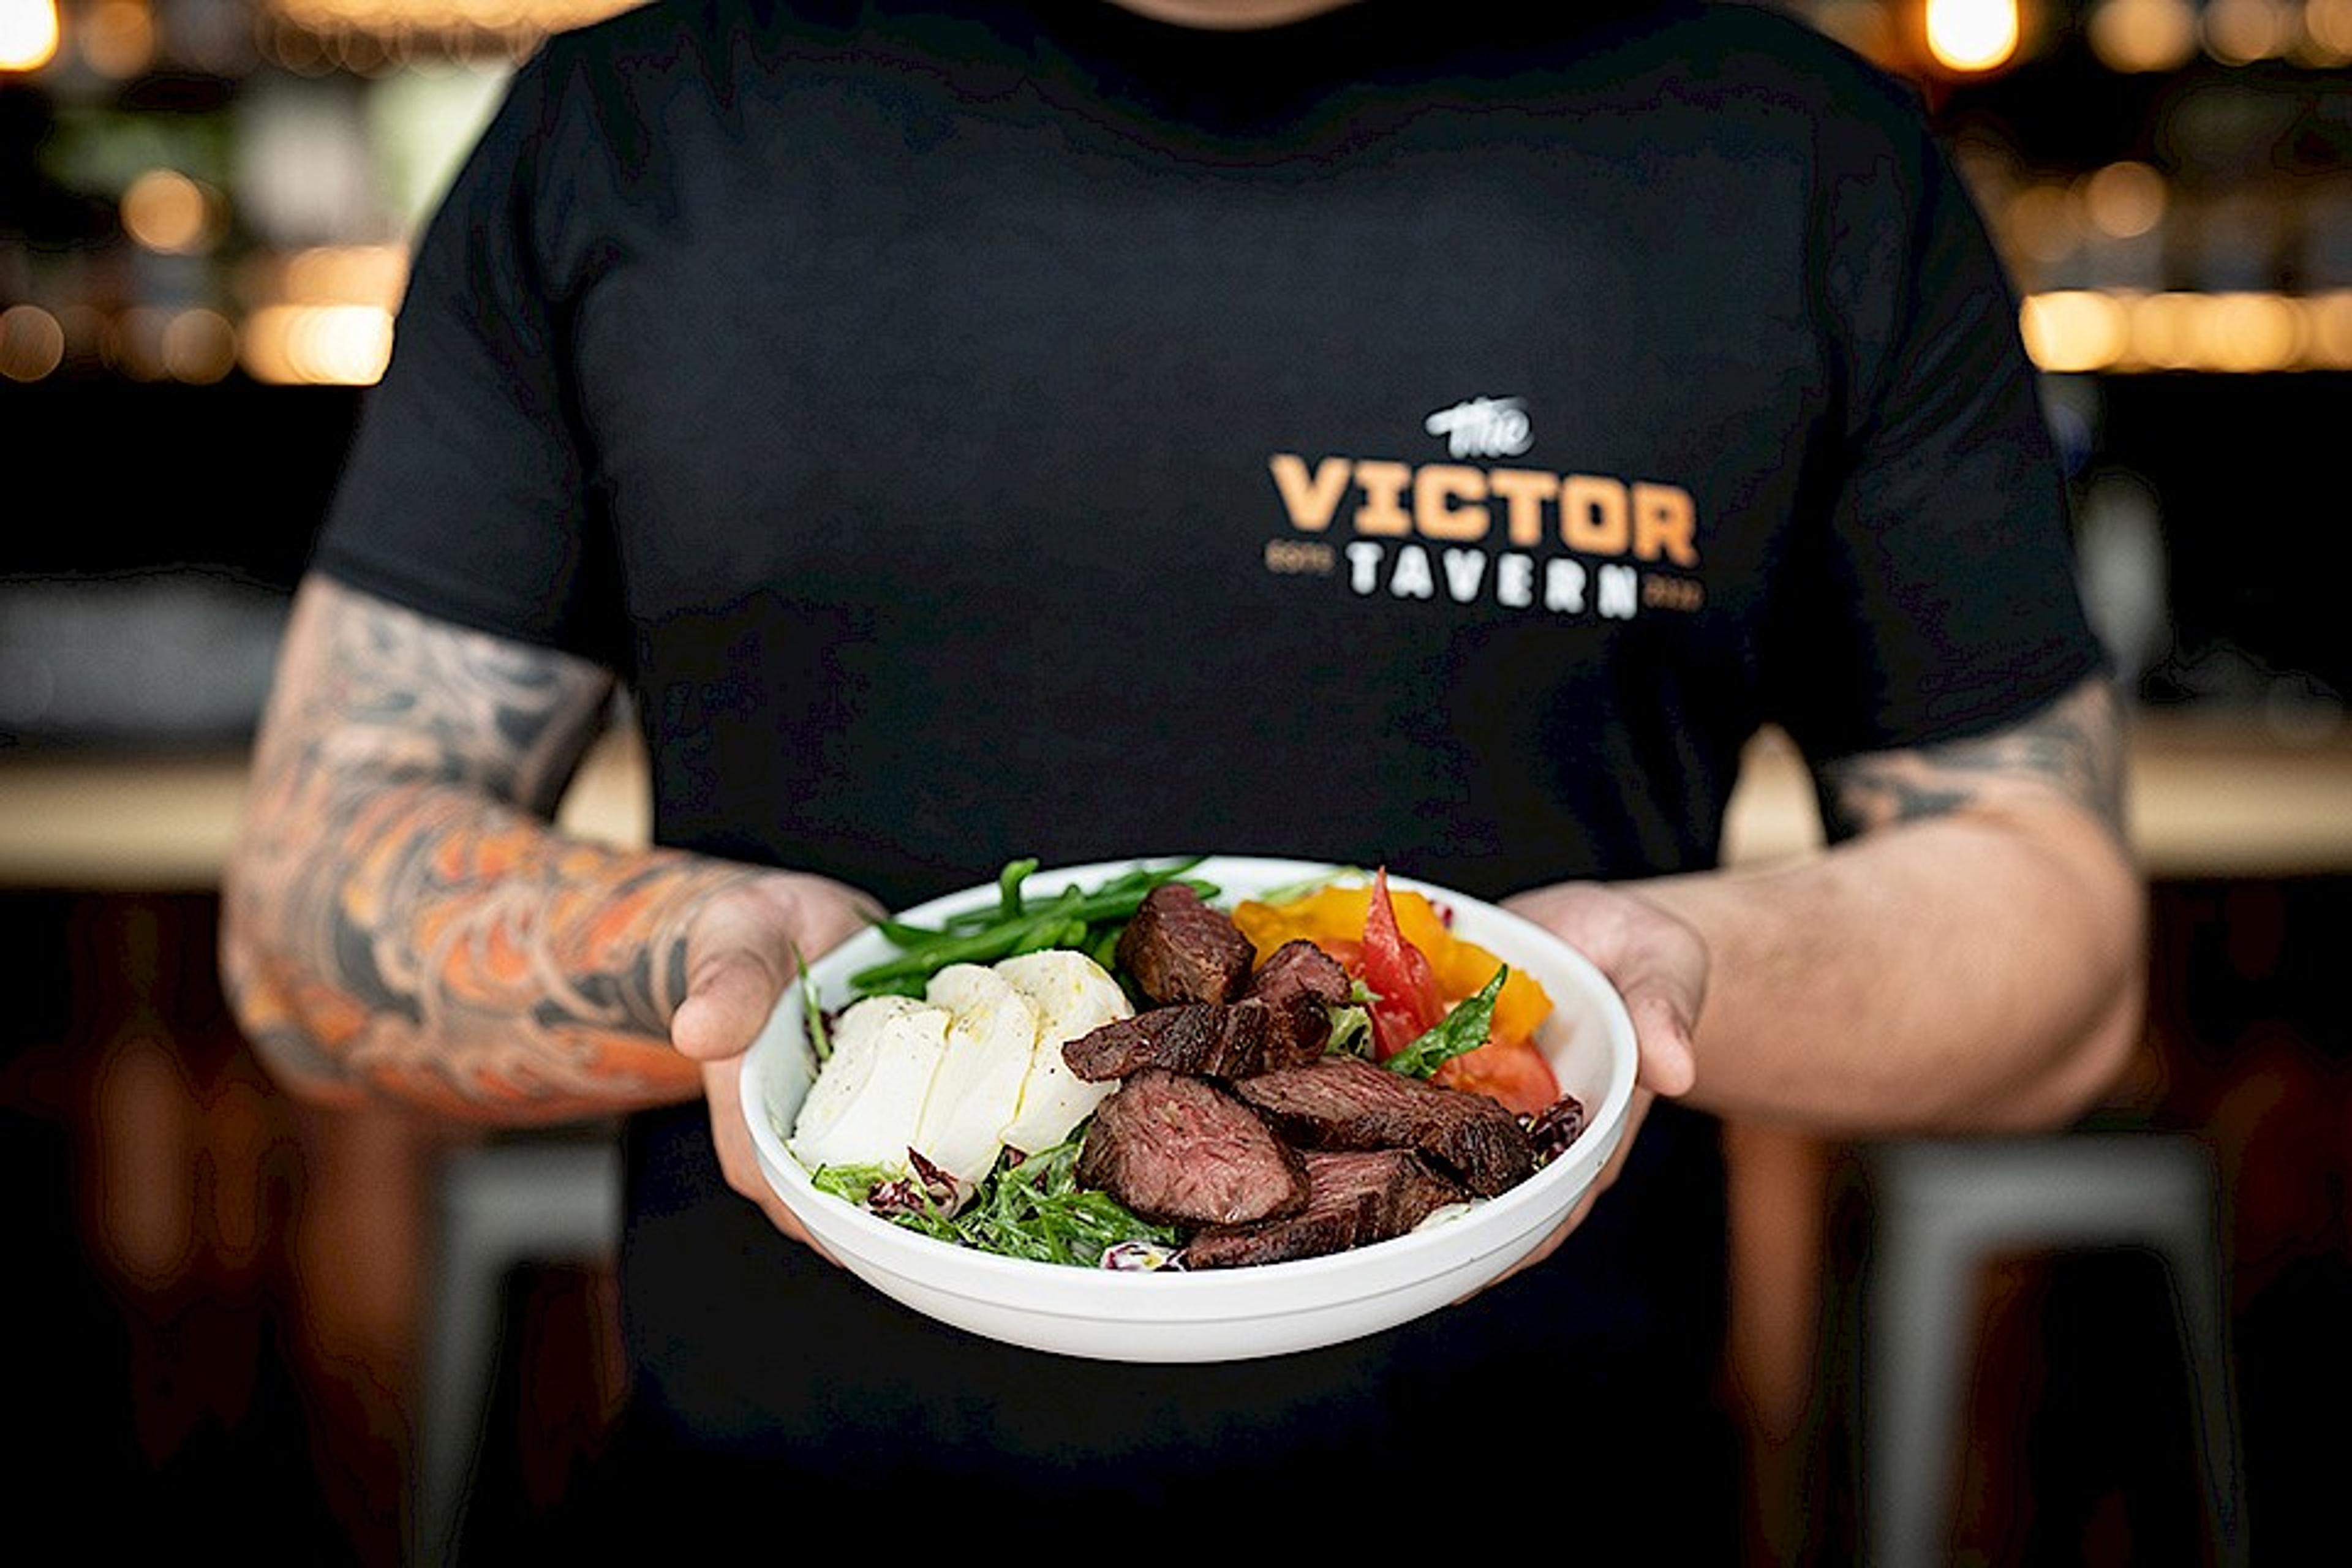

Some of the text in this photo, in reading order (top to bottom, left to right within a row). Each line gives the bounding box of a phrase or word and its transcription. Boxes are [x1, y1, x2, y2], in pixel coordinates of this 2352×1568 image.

[1426, 396, 1534, 458] The
[1270, 454, 1698, 568] VICTOR
[1346, 542, 1637, 620] TAVERN
